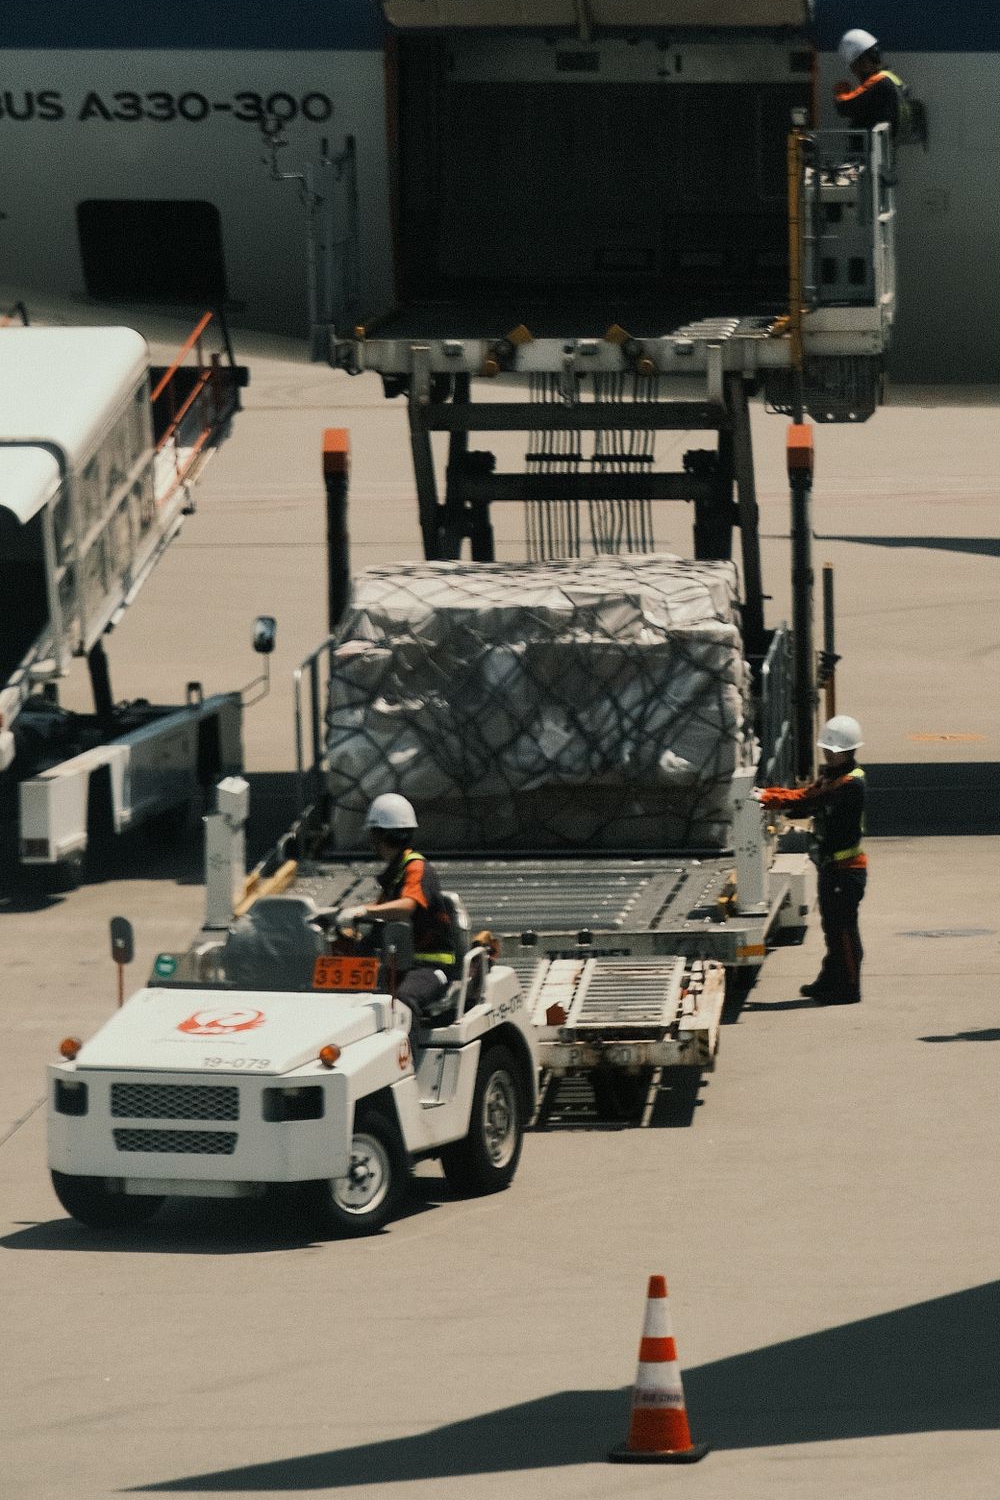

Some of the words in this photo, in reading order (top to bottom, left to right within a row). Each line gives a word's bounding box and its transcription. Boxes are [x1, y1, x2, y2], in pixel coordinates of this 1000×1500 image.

[0, 91, 65, 121] US
[78, 91, 333, 123] A330-300
[203, 1057, 271, 1069] 19-079
